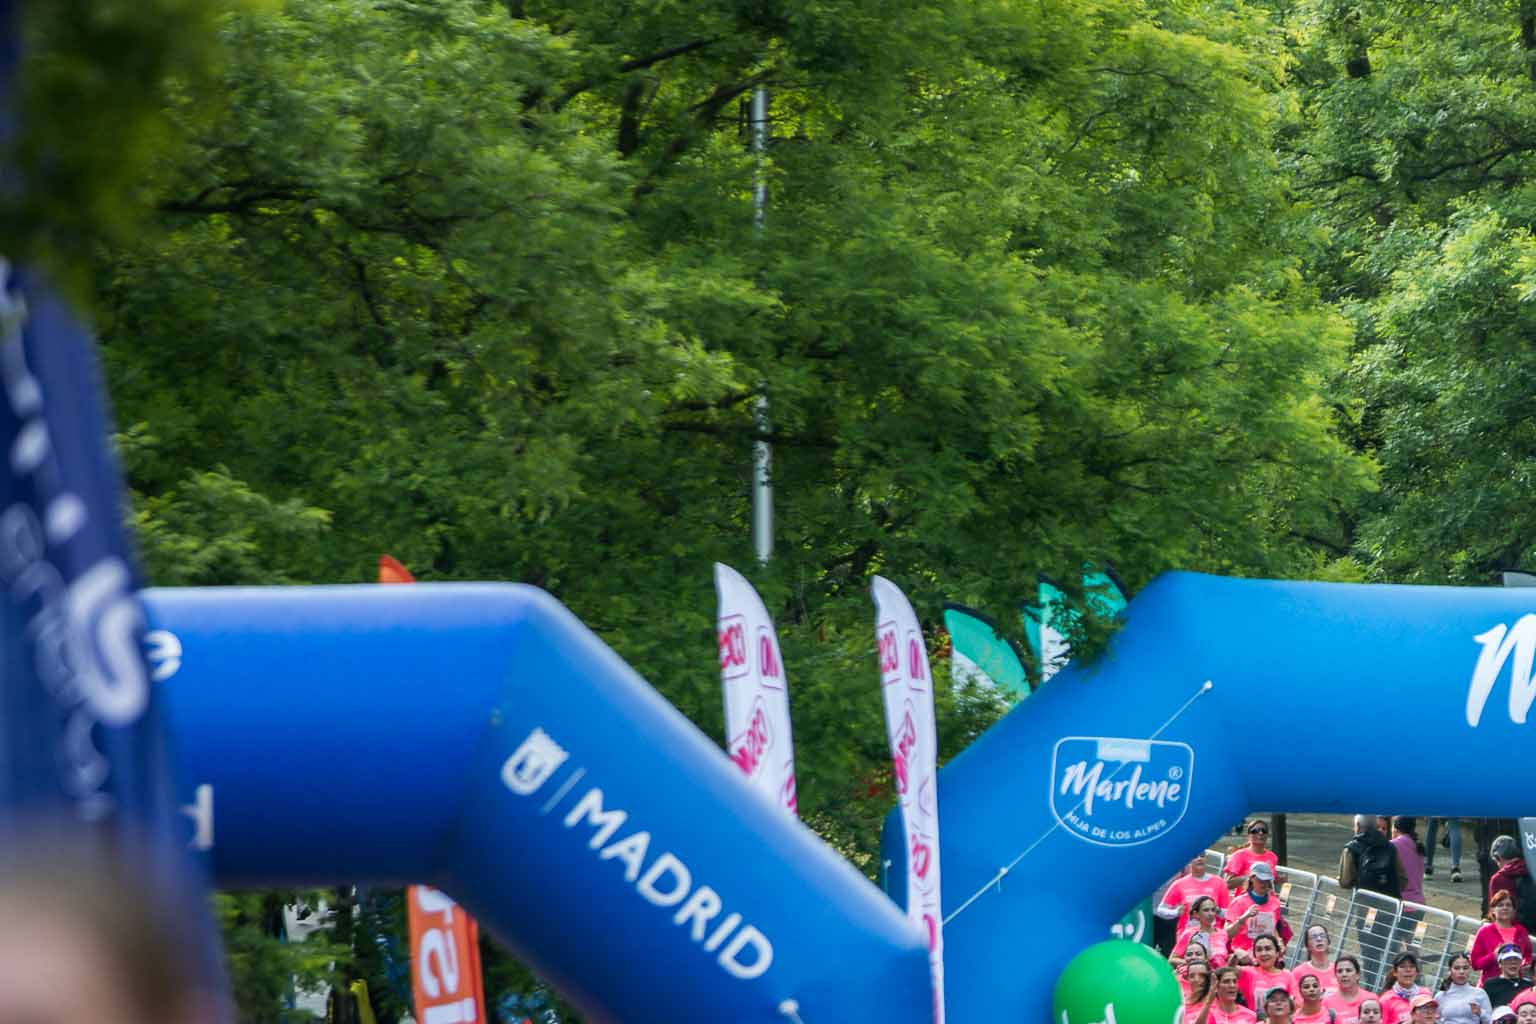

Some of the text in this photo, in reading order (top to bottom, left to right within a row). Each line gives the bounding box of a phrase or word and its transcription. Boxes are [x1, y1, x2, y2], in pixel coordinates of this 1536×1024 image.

[1060, 760, 1181, 816] Marlene
[1092, 825, 1106, 839] DE
[1110, 831, 1131, 840] LOS
[1134, 818, 1168, 839] ALPES
[563, 787, 774, 980] MADRID
